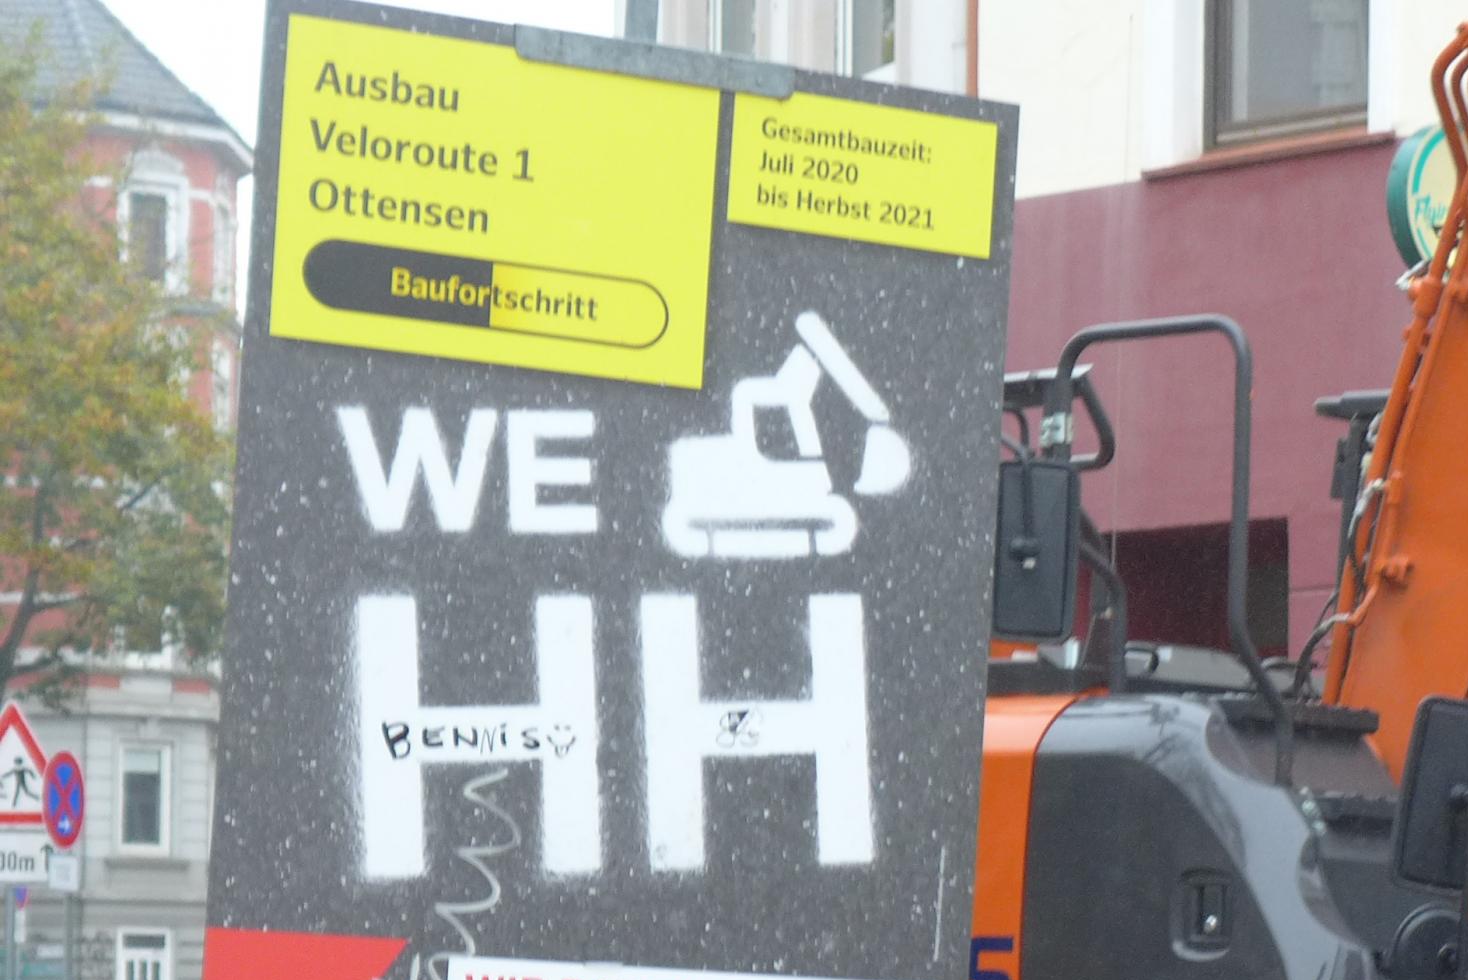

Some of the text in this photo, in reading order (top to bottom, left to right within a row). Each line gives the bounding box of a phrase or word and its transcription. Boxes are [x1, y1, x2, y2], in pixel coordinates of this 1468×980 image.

[314, 60, 459, 112] Ausbau
[310, 117, 535, 182] Veloroute 1
[761, 117, 933, 164] Gesamtbauzeit:
[759, 150, 859, 185] Juli 2020
[308, 177, 489, 234] Ottensen
[757, 183, 935, 231] bis Herbst 2021
[391, 266, 598, 321] Baufortschritt
[337, 406, 600, 534] WE
